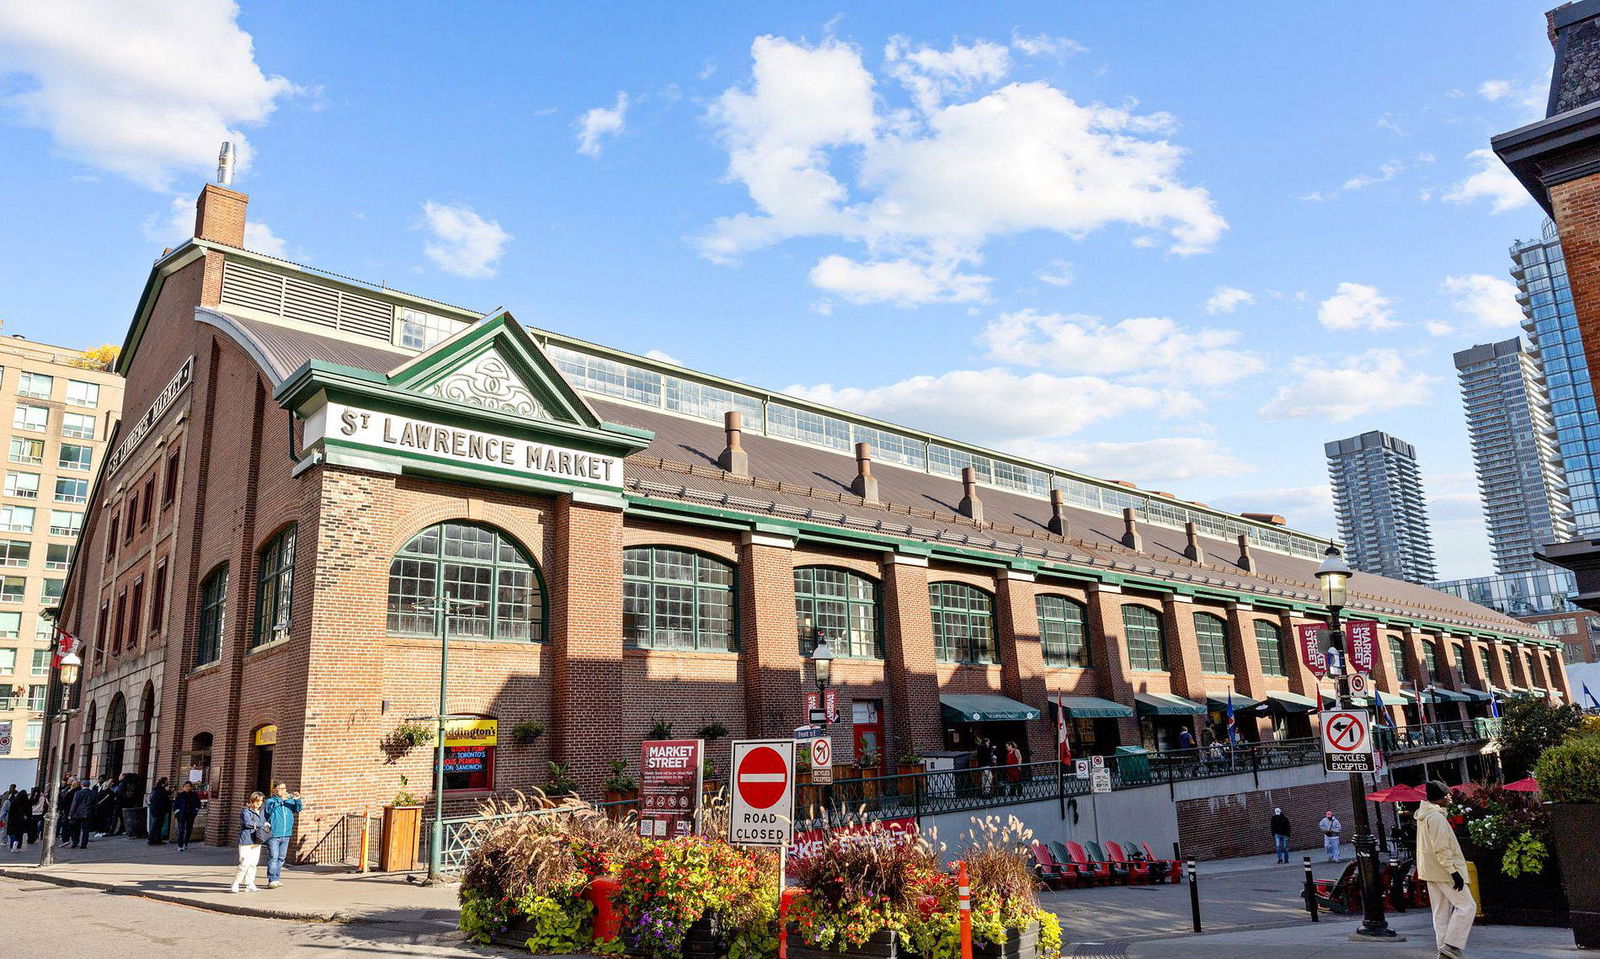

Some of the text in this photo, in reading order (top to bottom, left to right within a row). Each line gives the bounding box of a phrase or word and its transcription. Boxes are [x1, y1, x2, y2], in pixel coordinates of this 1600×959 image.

[383, 416, 515, 465] LAWRENCE
[526, 444, 614, 482] MARKET
[1304, 630, 1318, 667] STREET
[1313, 629, 1327, 670] KET
[1352, 627, 1364, 666] STREET
[1361, 627, 1372, 670] MARKET
[444, 726, 496, 739] ddington's
[650, 746, 694, 758] MARKET
[1332, 754, 1366, 762] BICYCLES
[648, 757, 690, 768] STREET
[1332, 762, 1368, 771] EXCEPTED
[744, 814, 777, 824] ROAD
[736, 828, 784, 840] CLOSED
